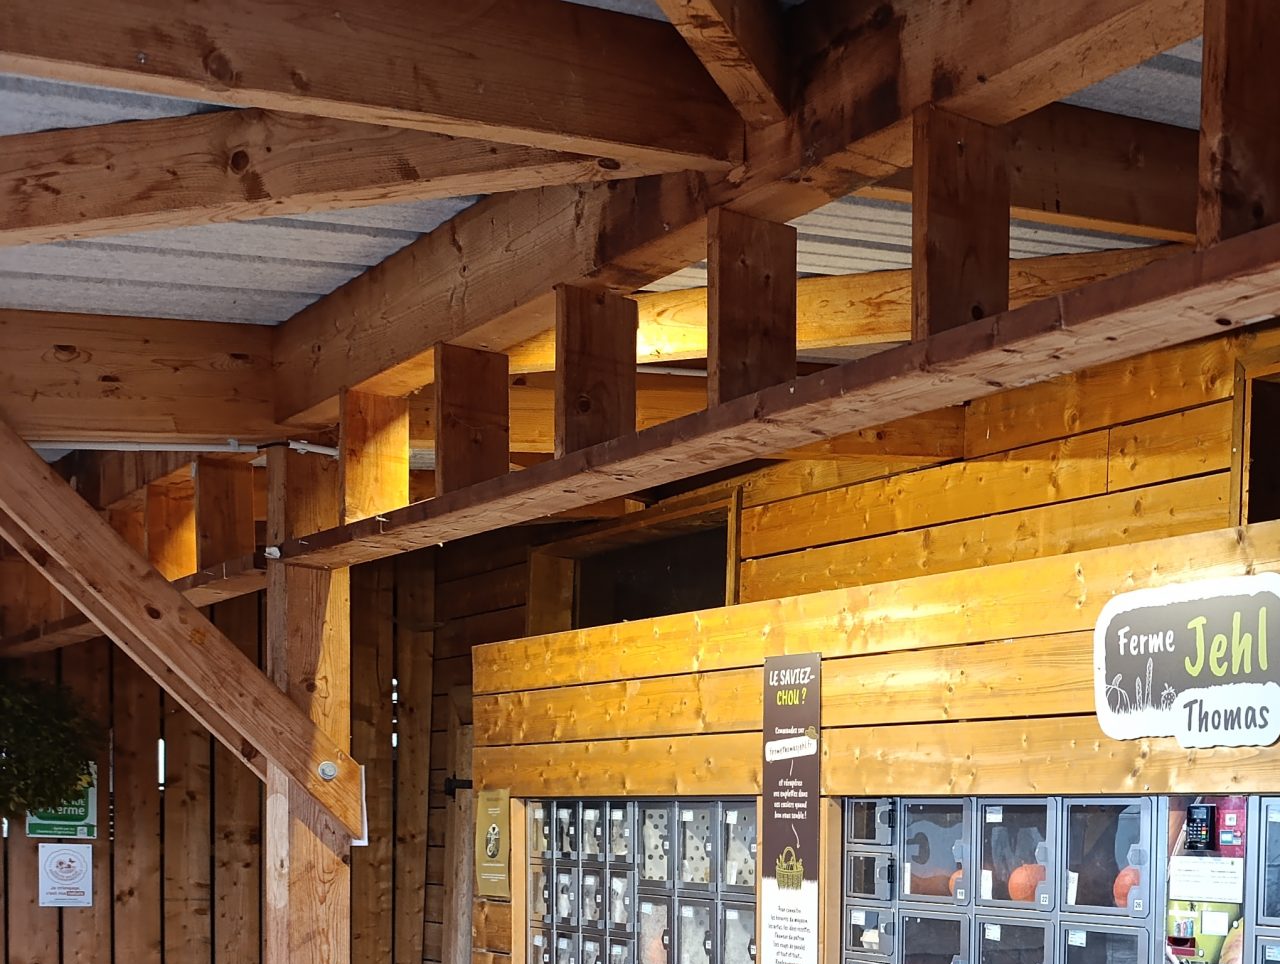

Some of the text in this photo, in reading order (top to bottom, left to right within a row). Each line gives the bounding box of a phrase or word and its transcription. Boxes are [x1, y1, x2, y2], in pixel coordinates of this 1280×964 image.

[1117, 606, 1269, 677] Ferme Jehl
[769, 666, 816, 686] LE SAVIEZ-
[776, 687, 807, 706] CHOU ?
[1183, 698, 1270, 733] Thomas
